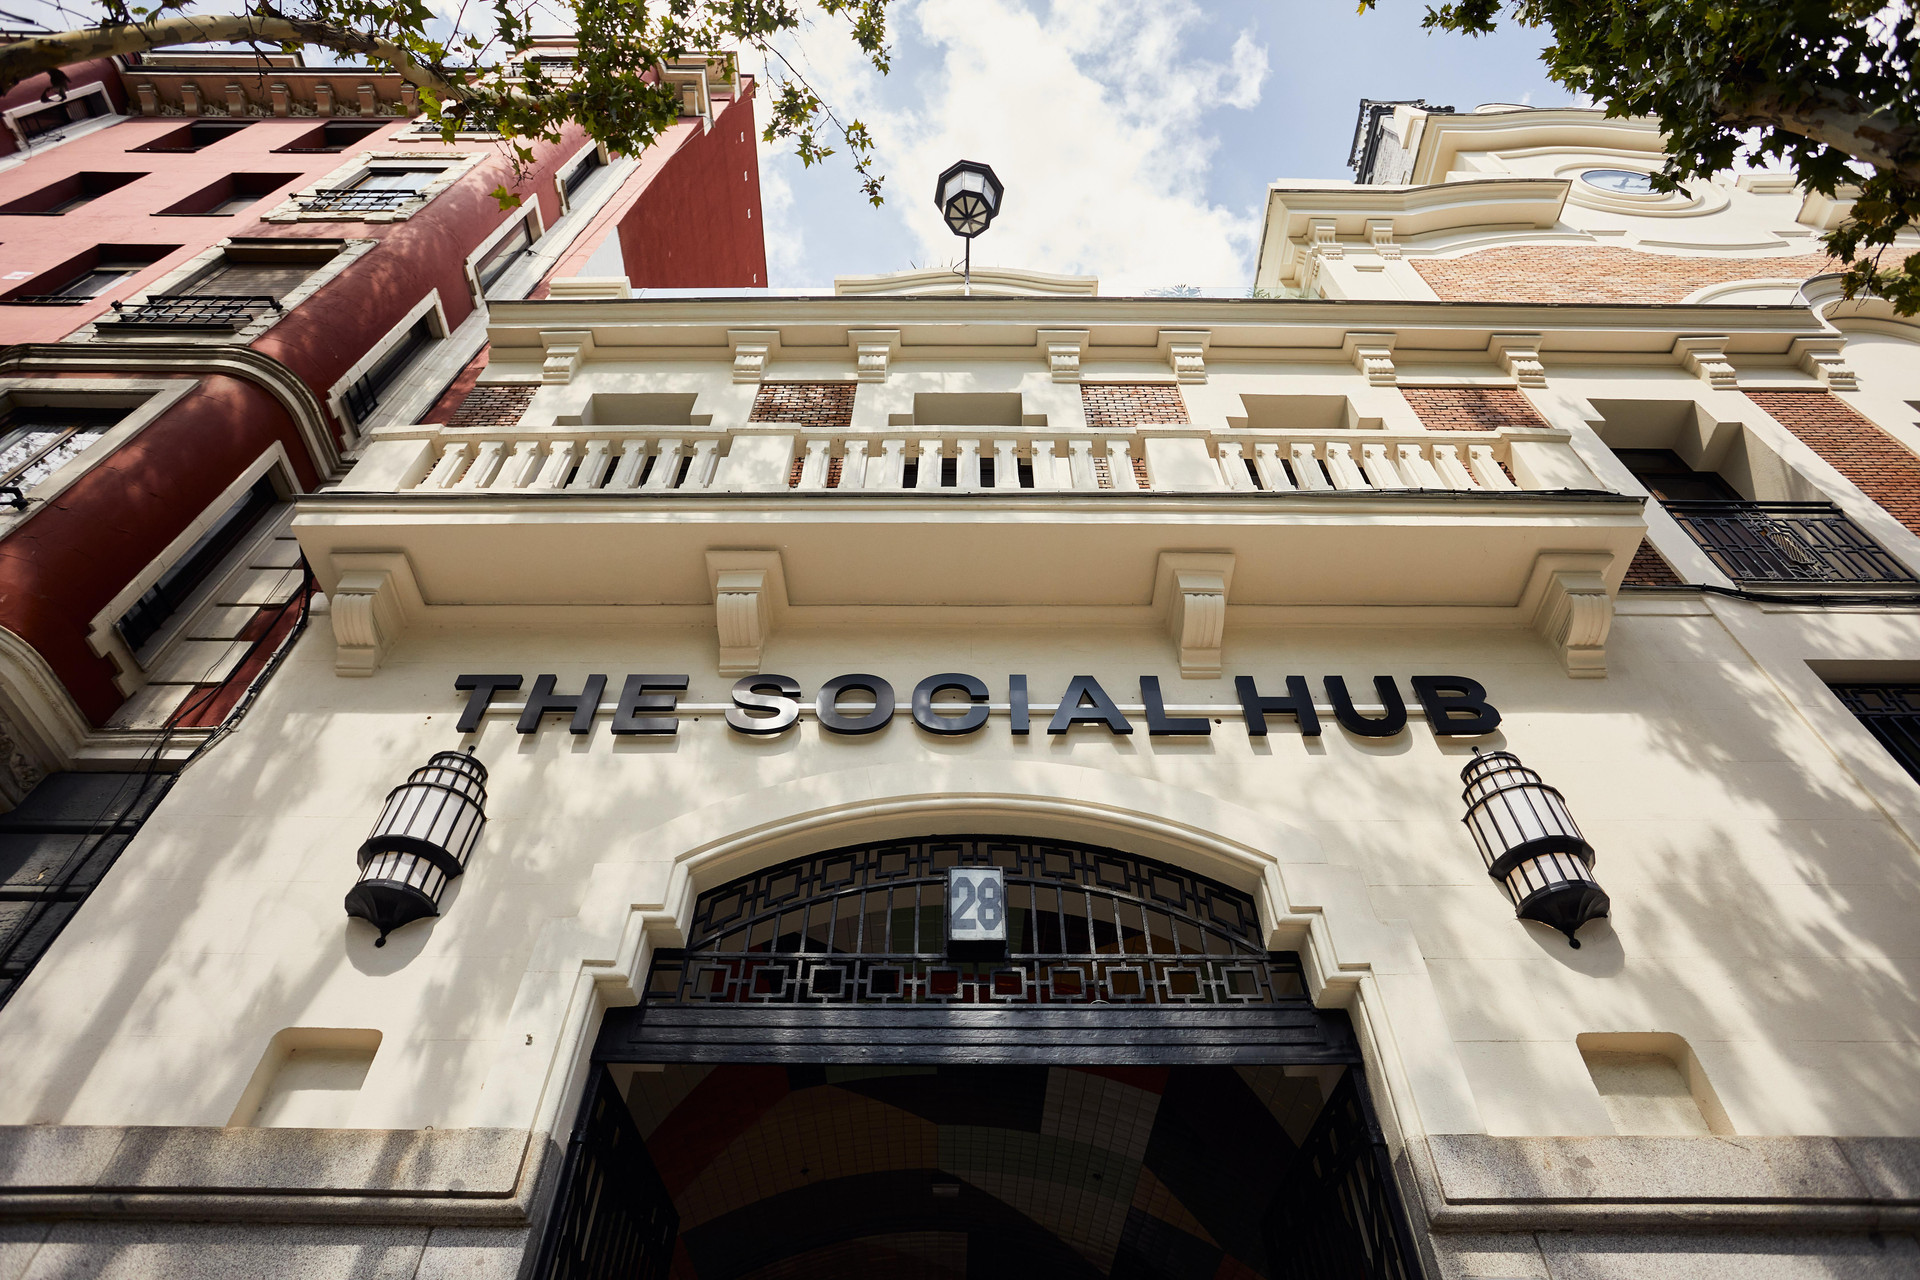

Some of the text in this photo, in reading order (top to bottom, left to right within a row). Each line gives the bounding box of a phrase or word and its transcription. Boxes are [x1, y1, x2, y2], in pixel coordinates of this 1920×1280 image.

[454, 673, 1502, 737] THE SOCIAL HUB
[951, 876, 1003, 931] 28
